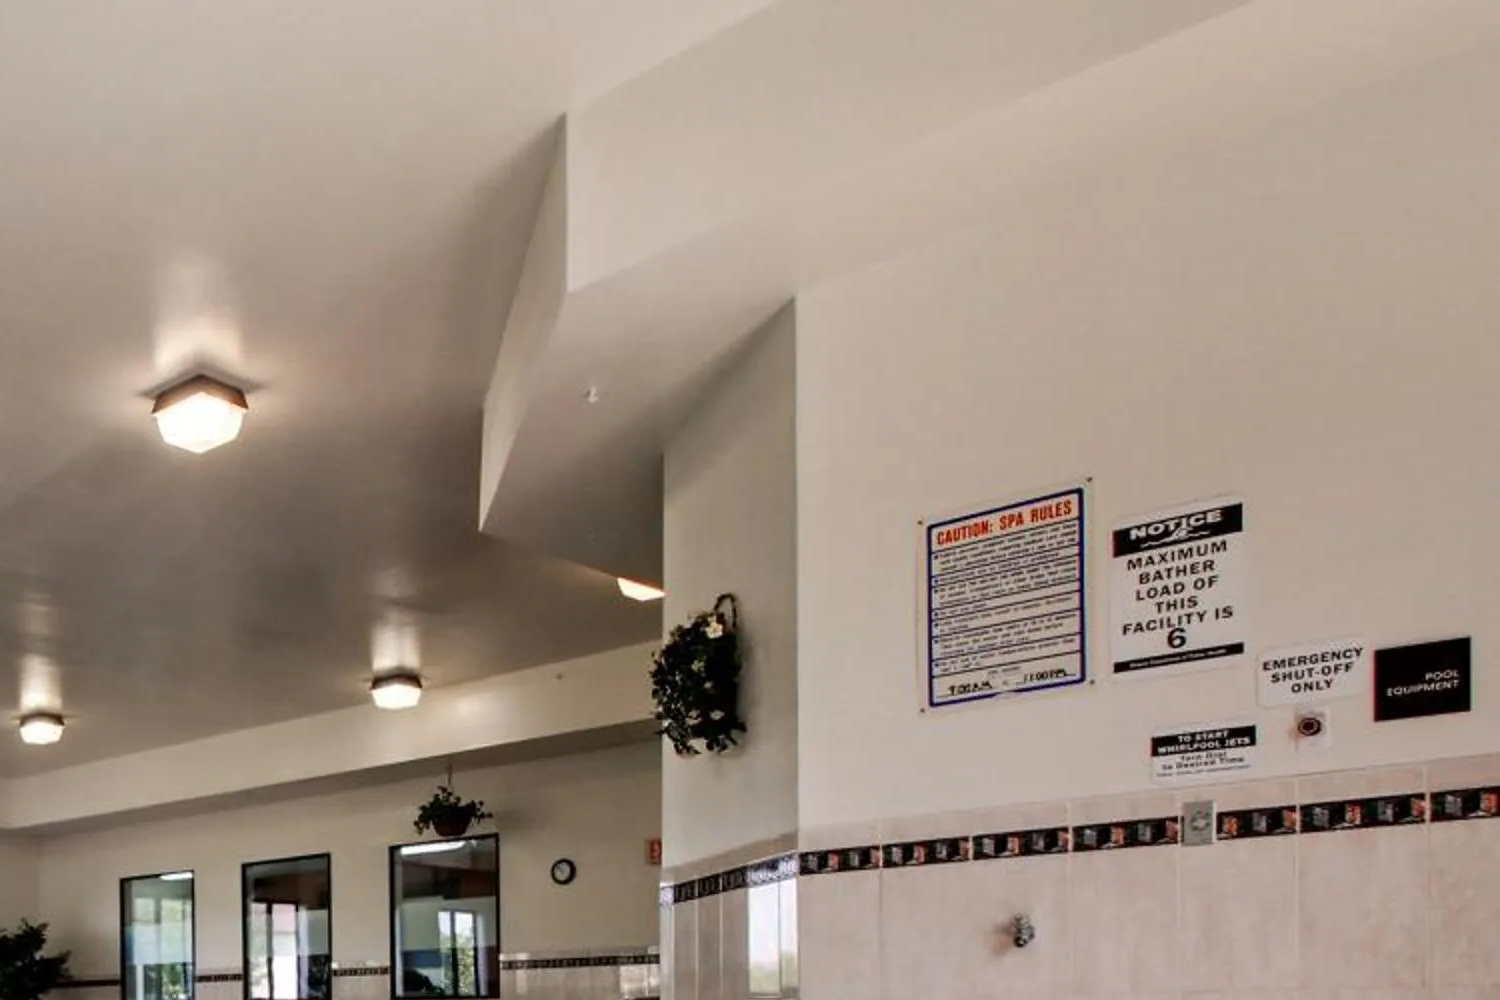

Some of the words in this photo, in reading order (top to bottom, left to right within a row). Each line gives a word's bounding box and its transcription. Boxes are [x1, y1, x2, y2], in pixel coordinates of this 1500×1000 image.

[937, 521, 993, 545] CAUTION:
[999, 511, 1024, 531] SPA
[1030, 500, 1072, 522] RULES
[1129, 509, 1224, 540] NOTICE
[1127, 540, 1227, 571] MAXIMUM
[1139, 560, 1215, 585] BATHER
[1135, 581, 1185, 601] LOAD
[1193, 575, 1218, 591] OF
[1155, 595, 1198, 614] THIS
[1122, 610, 1207, 636] FACILITY
[1215, 605, 1233, 621] IS
[1167, 627, 1187, 649] 6
[1262, 647, 1363, 671] EMERGENCY
[1270, 661, 1354, 683] SHUT-OFF
[1425, 669, 1460, 681] POOL
[1291, 679, 1333, 693] ONLY
[1386, 681, 1459, 697] EQUIPMENT
[1177, 735, 1191, 743] TO
[1195, 730, 1229, 741] START
